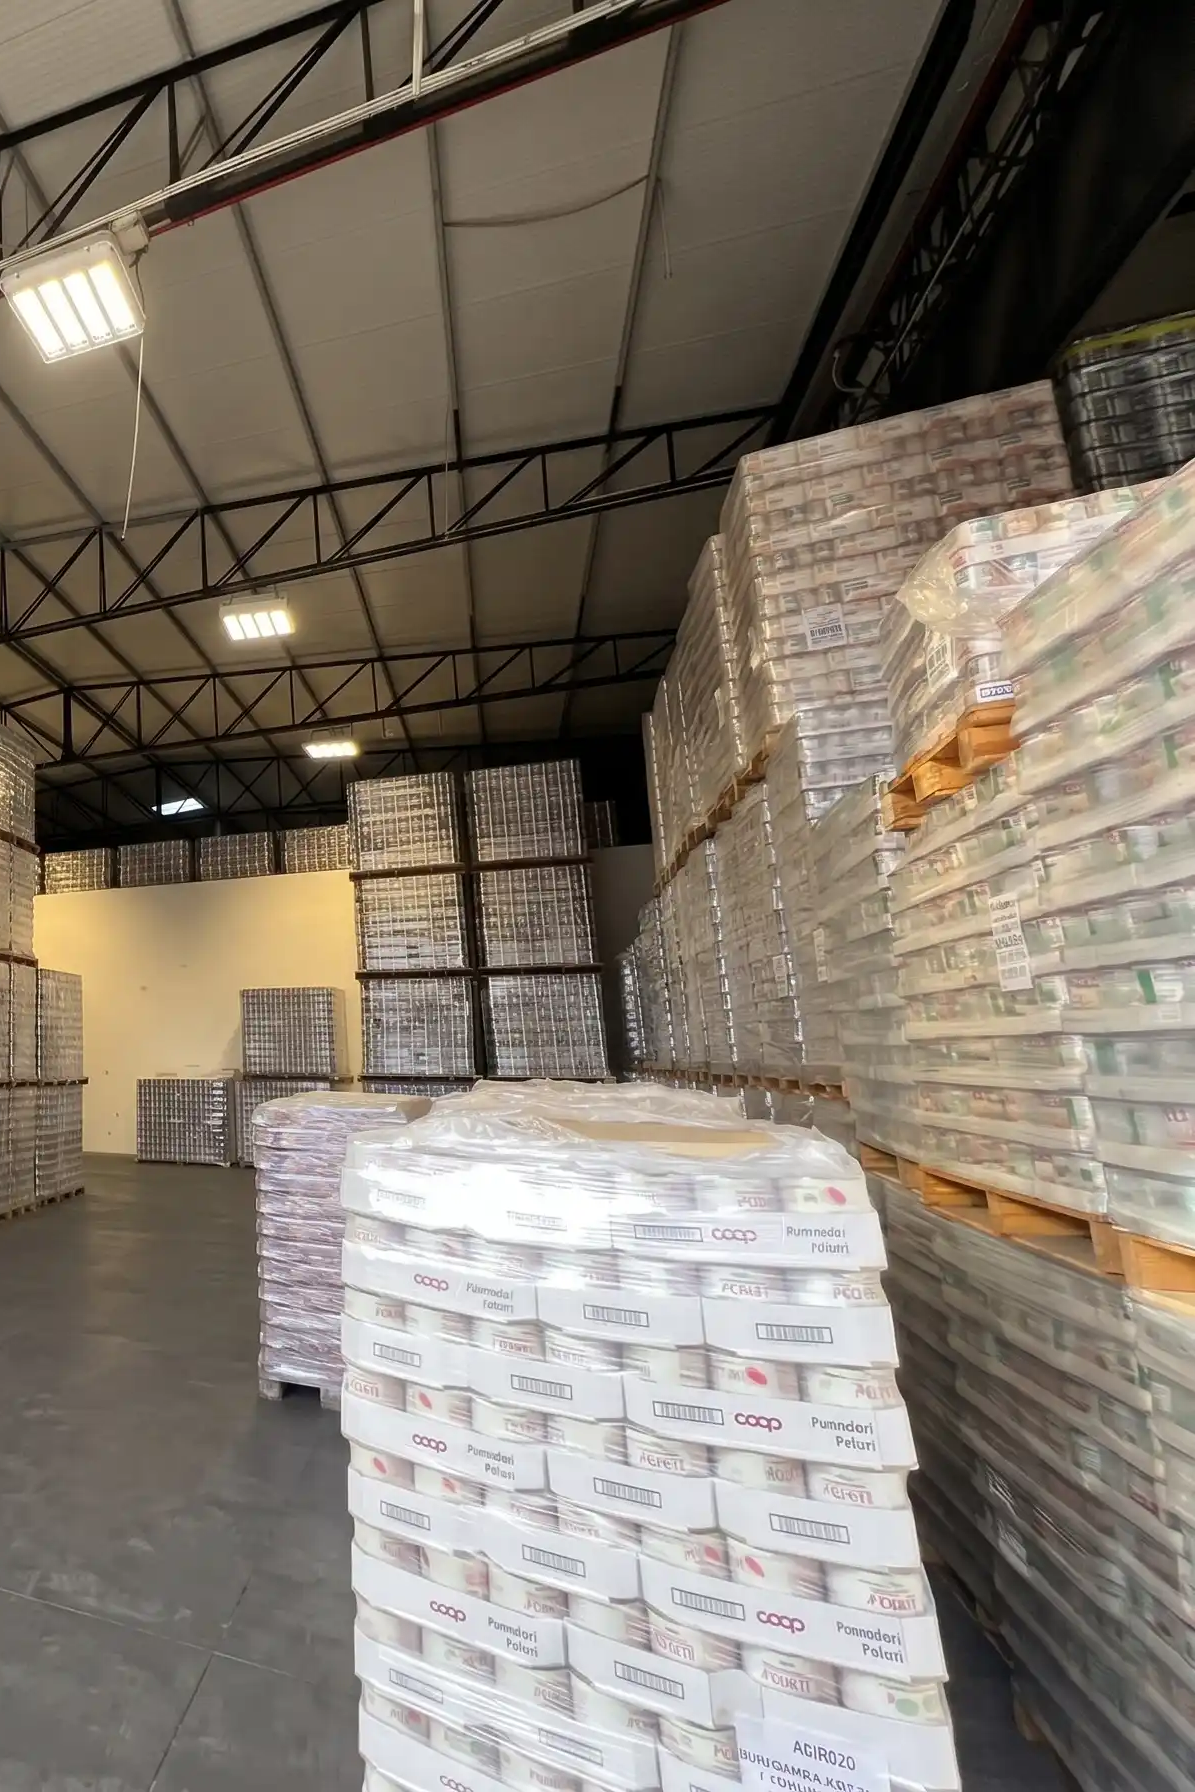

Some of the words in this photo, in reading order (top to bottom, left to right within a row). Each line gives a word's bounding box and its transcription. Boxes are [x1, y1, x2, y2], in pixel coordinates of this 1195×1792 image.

[712, 1228, 757, 1244] coop
[414, 1273, 449, 1291] coop
[734, 1412, 782, 1432] coop
[412, 1433, 447, 1453] coop
[429, 1600, 466, 1622] coop
[756, 1610, 806, 1634] coop
